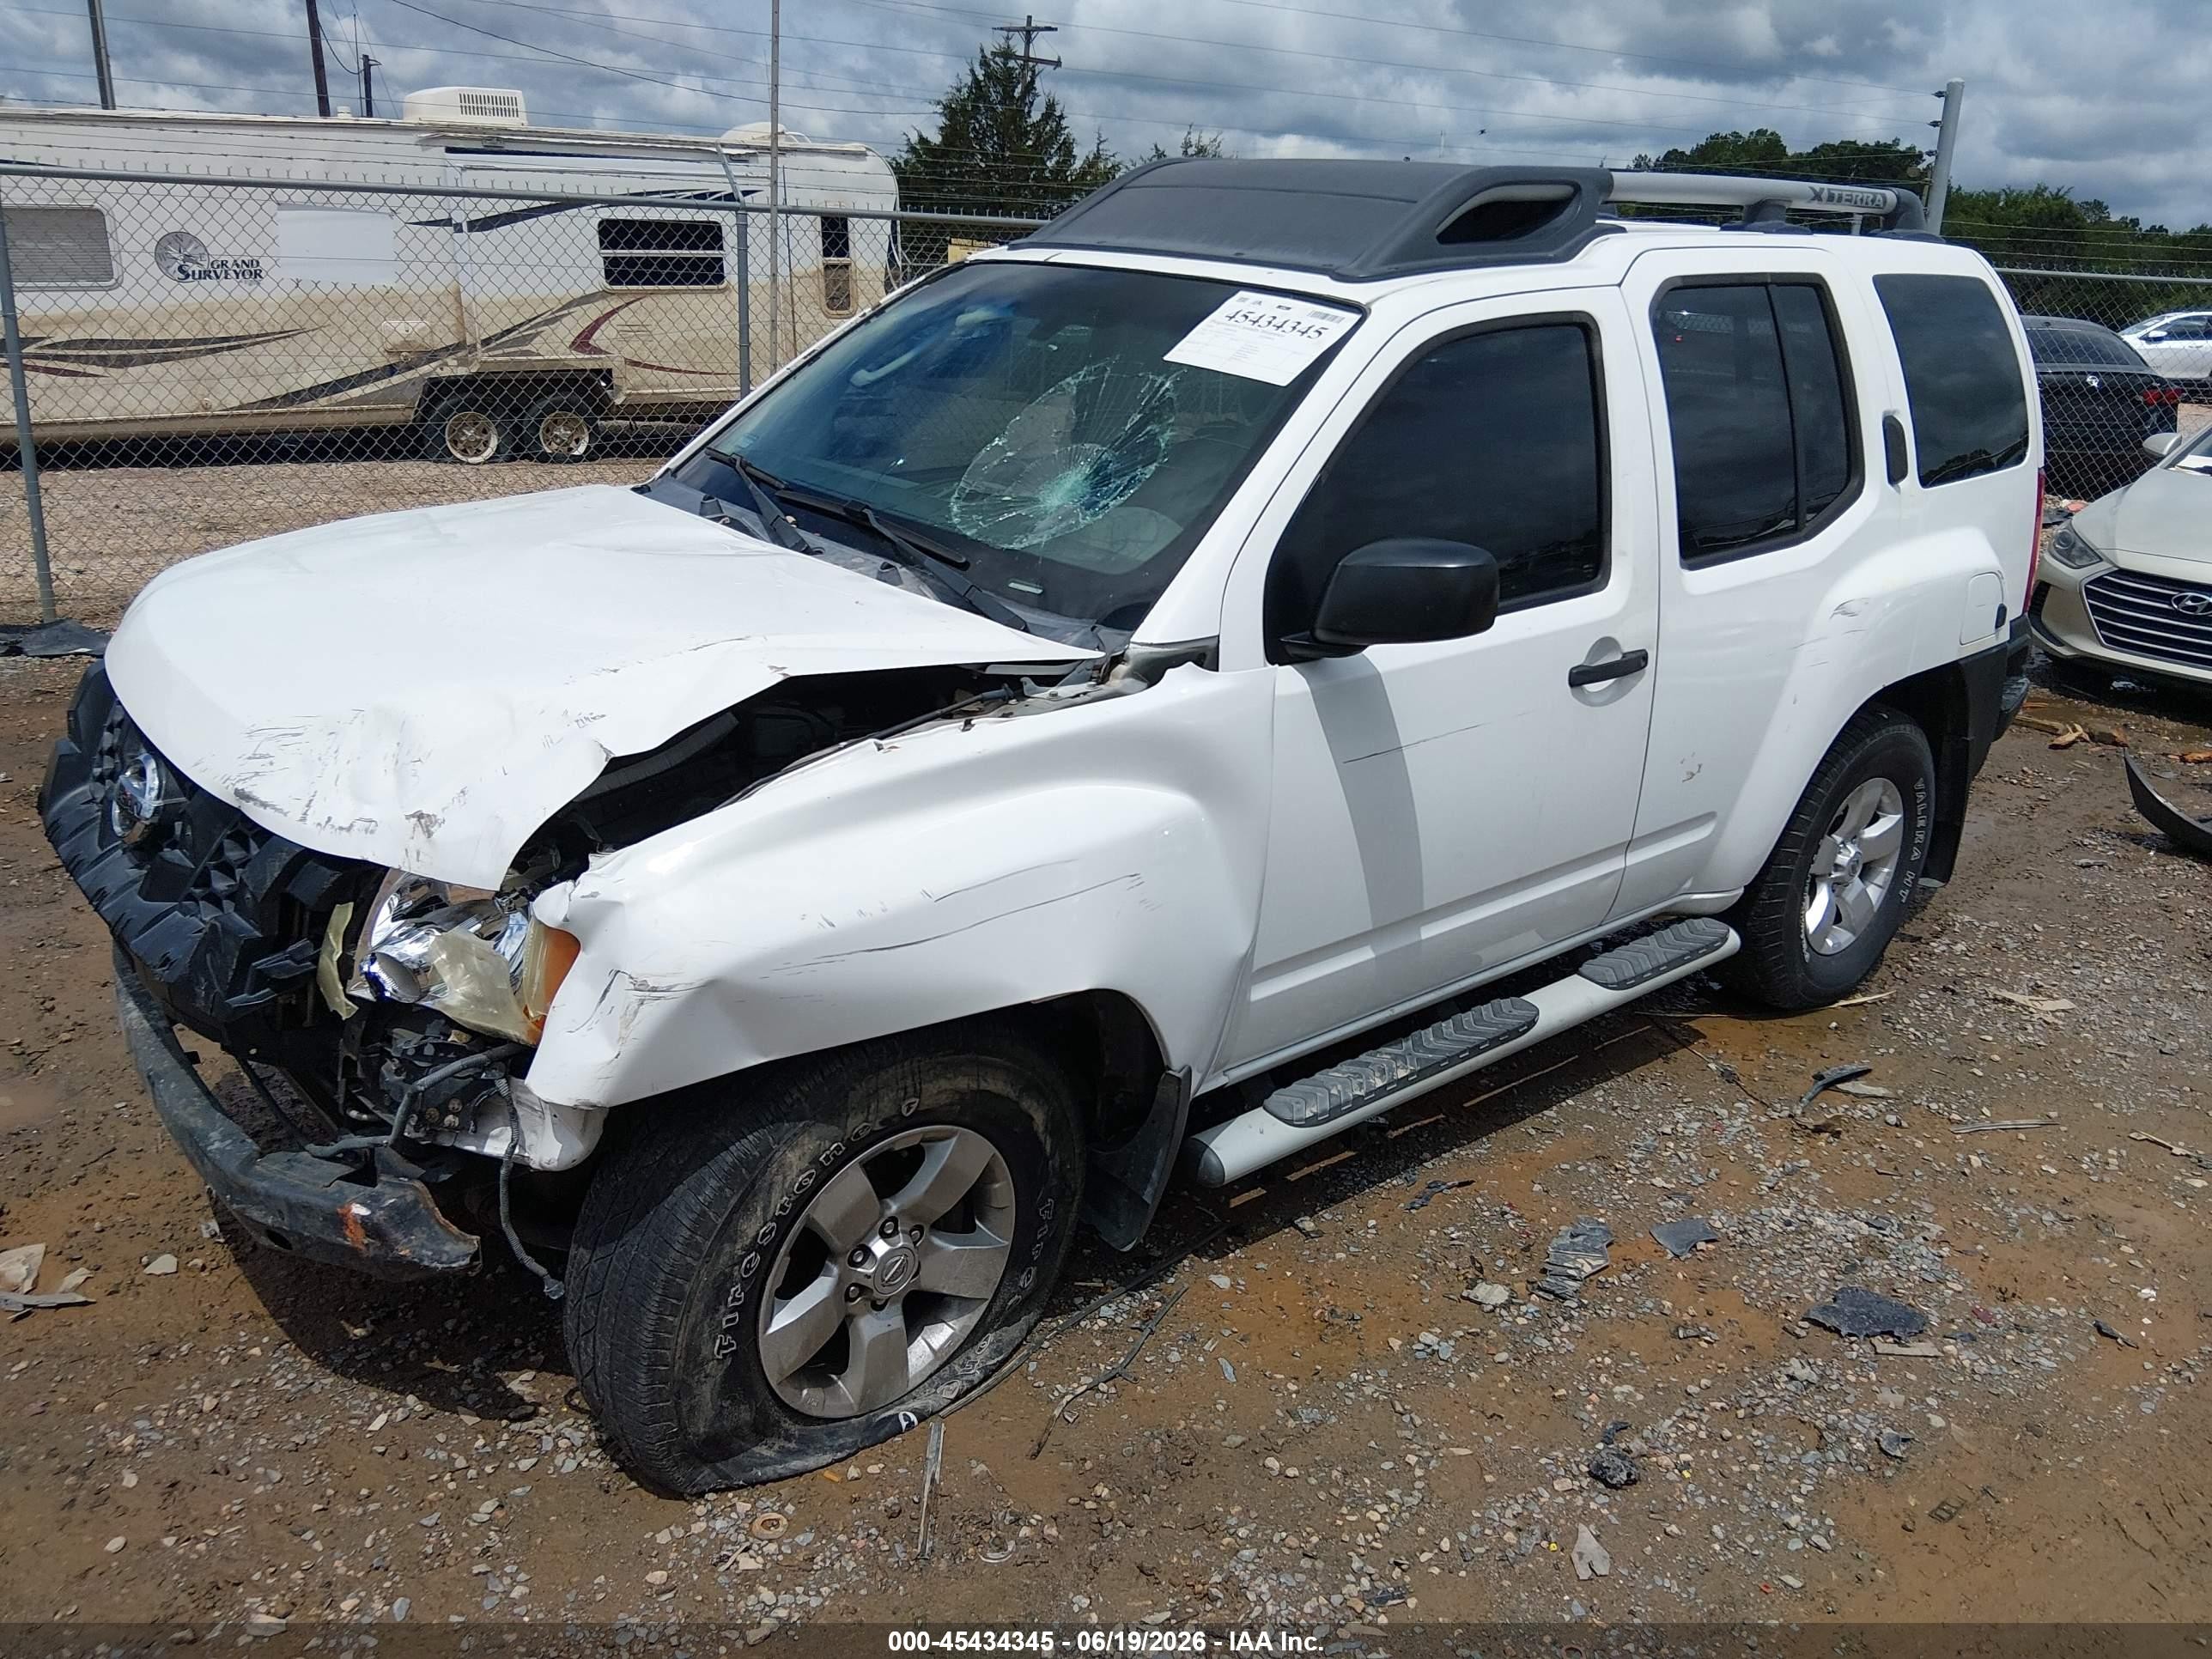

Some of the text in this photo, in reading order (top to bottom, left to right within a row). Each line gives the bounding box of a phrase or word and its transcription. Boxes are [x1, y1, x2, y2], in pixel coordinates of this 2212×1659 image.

[1808, 186, 1886, 208] XTERRA
[177, 264, 264, 280] SURVEYOR
[210, 259, 260, 269] GRAND
[1225, 309, 1329, 339] 45434345
